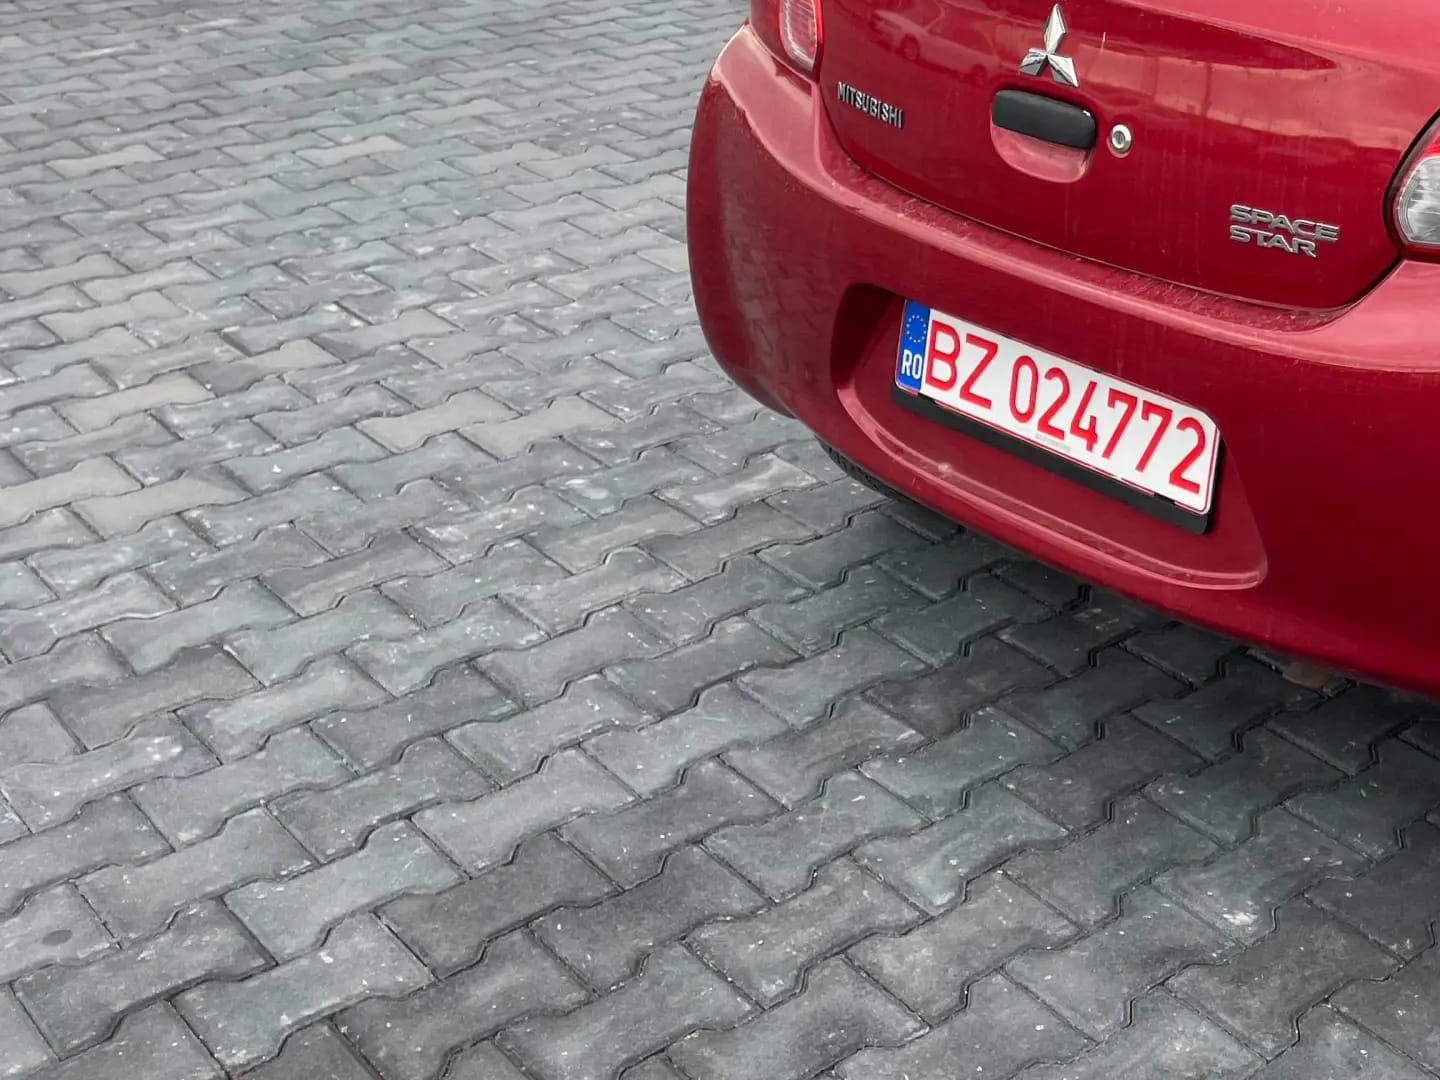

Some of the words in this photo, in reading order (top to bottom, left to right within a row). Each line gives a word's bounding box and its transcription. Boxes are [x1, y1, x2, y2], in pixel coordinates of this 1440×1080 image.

[837, 82, 903, 128] MITSUBISHI
[1229, 225, 1317, 258] STAR
[1230, 204, 1340, 242] SPACE
[901, 348, 923, 381] RO
[925, 322, 998, 410] BZ
[1009, 355, 1206, 494] 024772
